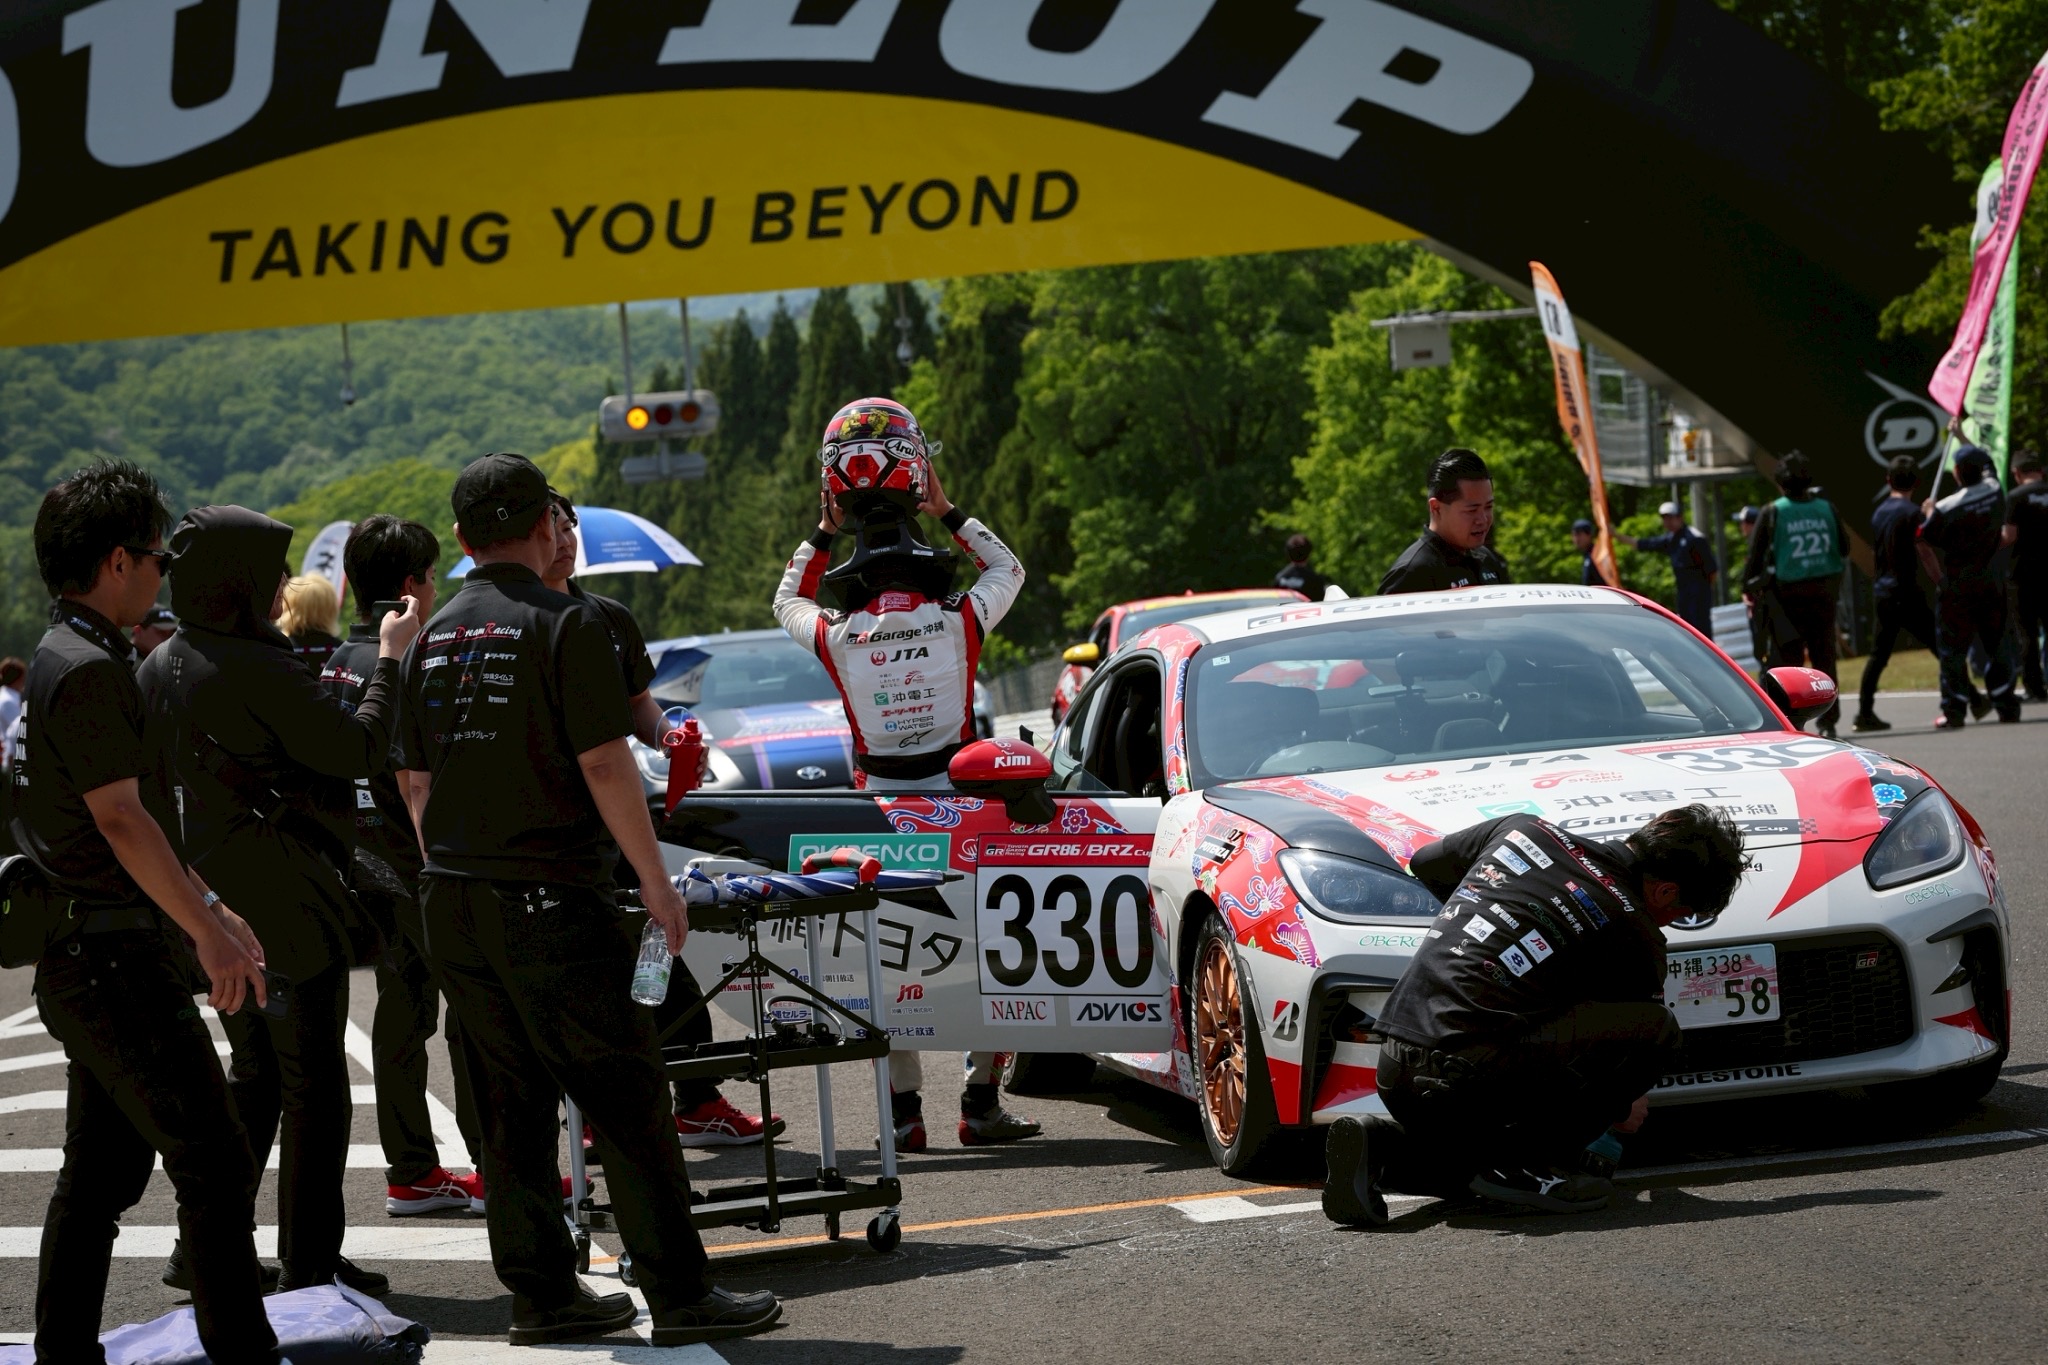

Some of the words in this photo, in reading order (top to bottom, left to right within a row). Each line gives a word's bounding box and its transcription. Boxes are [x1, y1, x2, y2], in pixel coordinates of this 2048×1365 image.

[0, 0, 1533, 225] UNLOP
[209, 212, 511, 284] TAKING
[551, 196, 716, 258] YOU
[750, 170, 1080, 245] BEYOND
[889, 440, 915, 457] Arai
[1786, 518, 1829, 534] MEDIA
[870, 628, 922, 643] Garage
[890, 646, 930, 663] JTA
[892, 687, 936, 704] 沖電工
[897, 715, 934, 725] HYPER
[1456, 753, 1591, 774] JTA
[1553, 786, 1742, 811] 沖電工
[1557, 812, 1657, 829] Gara
[1754, 825, 1789, 833] Cup
[799, 843, 940, 862] OENKO
[1027, 843, 1135, 857] GR86/BRZ
[1198, 840, 1231, 859] POTENZA
[984, 873, 1154, 989] 330
[1359, 935, 1426, 948] OBERO
[1706, 953, 1743, 976] 338
[896, 983, 924, 1004] JTB
[1724, 976, 1771, 1018] 58
[991, 1000, 1048, 1021] NAPAC
[1076, 1002, 1163, 1022] ADVICS
[885, 1026, 936, 1037] テレビ放送
[1652, 1063, 1802, 1090] DGESTONE
